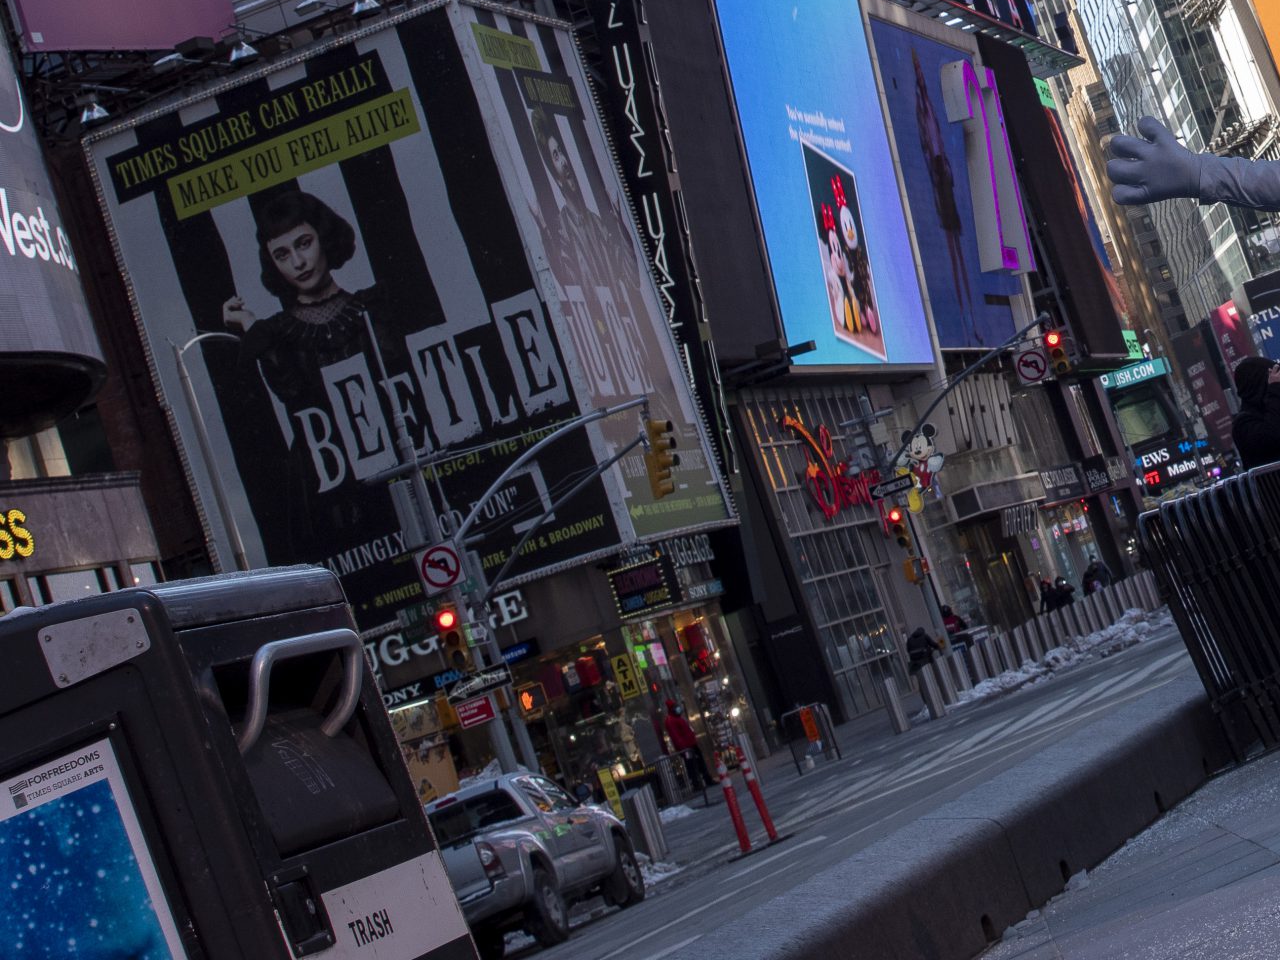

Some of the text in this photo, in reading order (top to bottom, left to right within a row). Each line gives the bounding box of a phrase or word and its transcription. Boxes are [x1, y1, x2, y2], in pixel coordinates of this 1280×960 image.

[115, 59, 378, 190] TIMES SQUARE CAN REALLY
[177, 98, 411, 209] MAKE YOU FEEL ALIVE!
[294, 289, 571, 494] BEETLE
[1141, 447, 1170, 468] EWS
[1088, 472, 1107, 483] POLO
[548, 513, 606, 545] BROADWAY
[688, 585, 708, 599] SONY
[407, 602, 434, 622] W 46
[482, 670, 507, 686] WAY
[616, 657, 635, 692] ATM
[27, 764, 104, 801] TIMES SQUARE ARTS
[348, 908, 394, 948] TRASH
